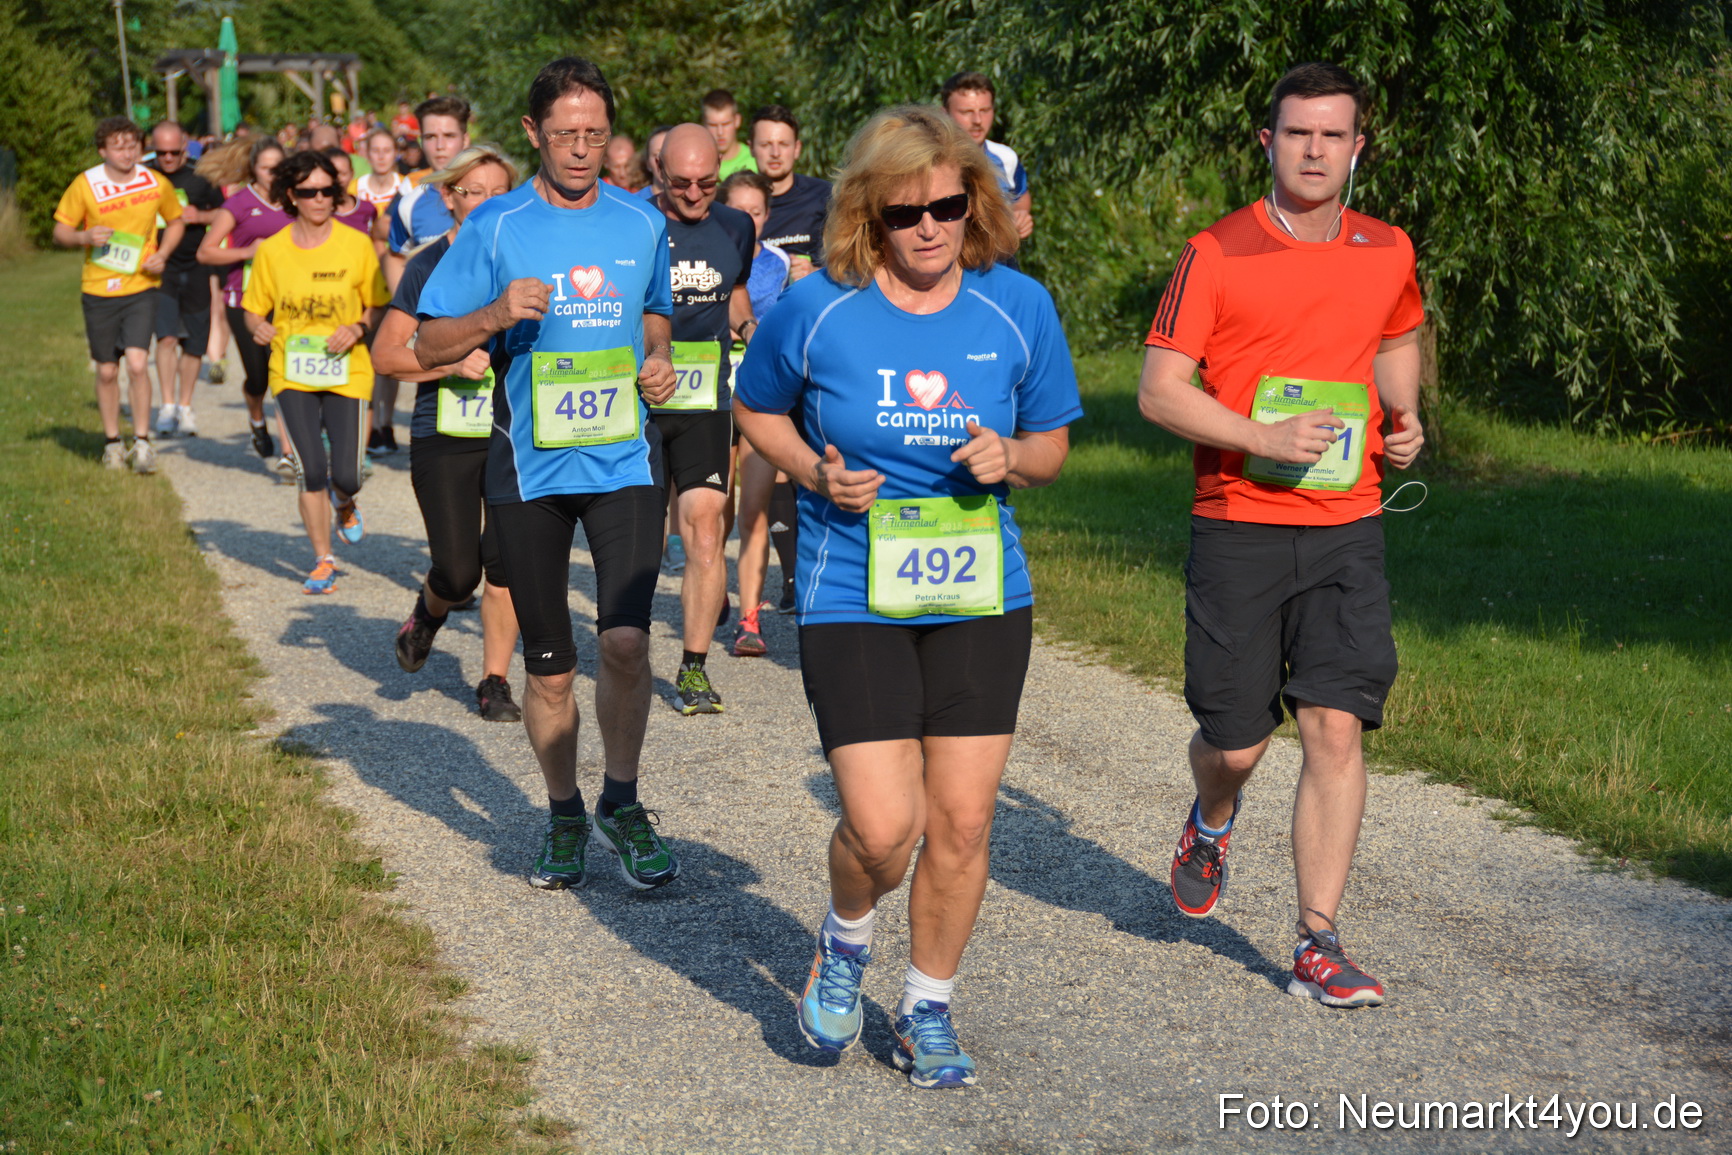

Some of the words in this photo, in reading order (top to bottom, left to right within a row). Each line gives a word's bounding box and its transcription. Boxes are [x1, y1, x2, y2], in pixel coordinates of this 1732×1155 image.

[552, 274, 567, 301] I
[670, 267, 721, 290] Burgis
[554, 298, 623, 319] camping
[687, 291, 717, 306] guad
[597, 318, 622, 328] Berger
[292, 357, 343, 377] 1528
[674, 369, 703, 391] 70
[877, 368, 897, 407] I
[457, 395, 494, 418] 17
[555, 387, 619, 421] 487
[1274, 395, 1317, 407] firmenlauf
[1275, 462, 1303, 472] Werner
[890, 517, 939, 528] firmenlauf
[896, 545, 977, 585] 492
[915, 594, 937, 602] Petra
[937, 592, 961, 601] Kraus
